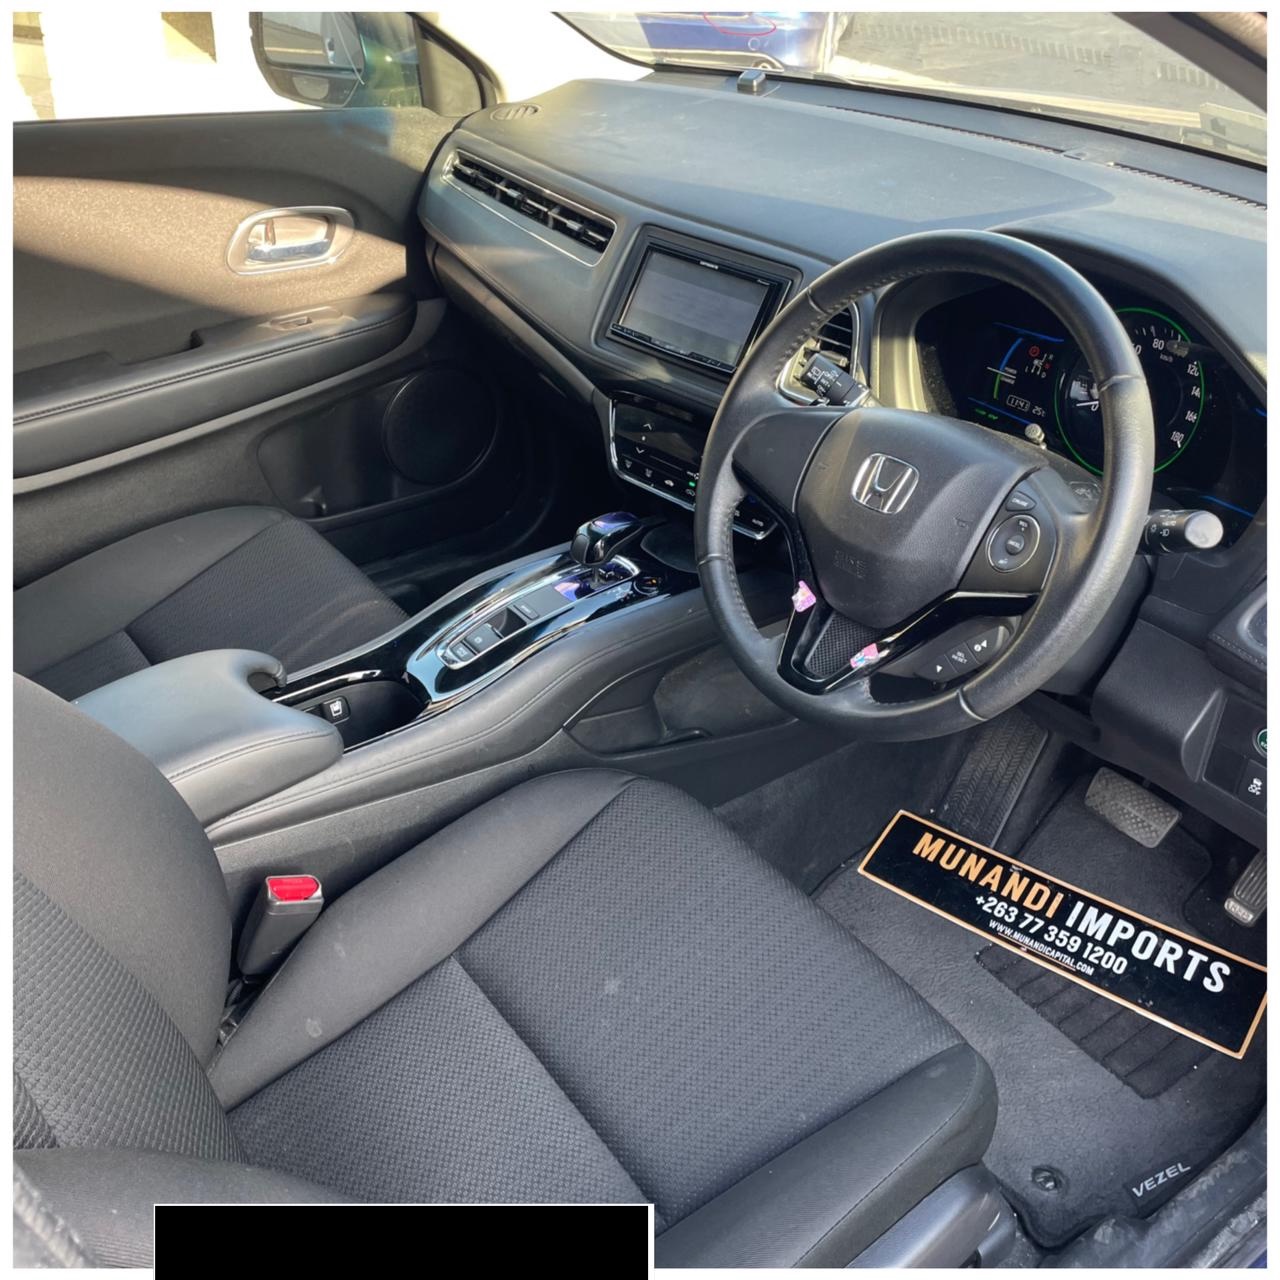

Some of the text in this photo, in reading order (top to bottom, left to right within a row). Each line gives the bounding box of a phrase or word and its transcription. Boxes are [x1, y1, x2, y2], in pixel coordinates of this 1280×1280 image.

[1152, 338, 1165, 351] 80
[1191, 385, 1201, 398] 14
[913, 832, 1231, 993] MUNANDI IMPORTS
[975, 895, 1128, 975] +263 77 359 1200
[988, 919, 1095, 976] WWW.MUNANDICAPITAL.COM
[1132, 1161, 1191, 1198] VEZEL
